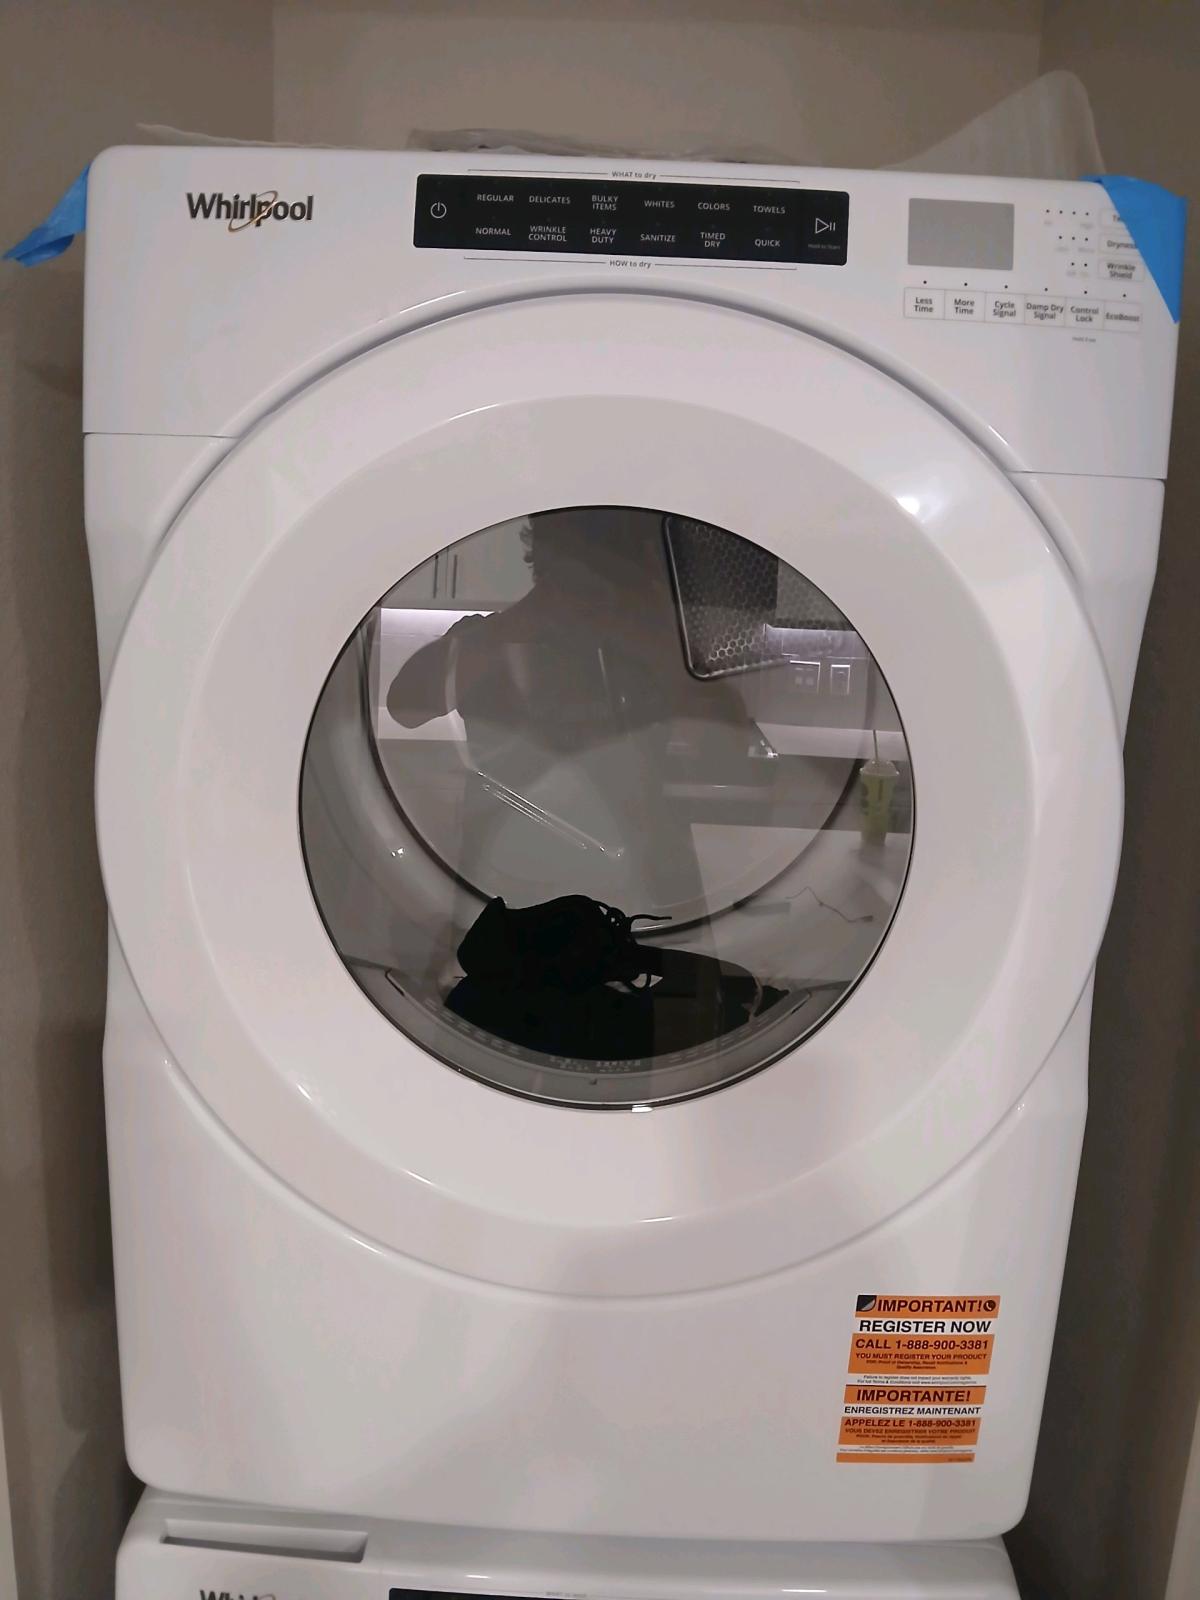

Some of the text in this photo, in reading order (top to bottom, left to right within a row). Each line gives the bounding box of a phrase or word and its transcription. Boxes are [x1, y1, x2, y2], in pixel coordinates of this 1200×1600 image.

[611, 170, 633, 178] WHAT
[644, 172, 656, 180] dry
[476, 193, 514, 203] REGULAR
[528, 195, 571, 205] DELICATES
[591, 195, 619, 203] BULKY
[186, 192, 314, 227] Whirlpool
[592, 203, 617, 211] ITEMS
[643, 200, 676, 209] WHITES
[697, 202, 730, 212] COLORS
[752, 205, 786, 215] TOWELS
[475, 227, 512, 237] NORMAL
[529, 225, 567, 234] WRINKLE
[589, 228, 617, 236] HEAVY
[528, 233, 567, 242] CONTROL
[591, 236, 615, 244] DUTY
[639, 233, 677, 243] SANITIZE
[700, 231, 726, 240] TIMED
[704, 239, 721, 248] DRY
[754, 238, 781, 248] QUICK
[639, 261, 652, 269] dry
[1106, 262, 1136, 272] Wrinkle
[1109, 270, 1133, 280] Shield
[915, 296, 933, 305] Less
[954, 298, 975, 307] More
[994, 300, 1015, 311] Cycle
[914, 304, 934, 313] Time
[954, 306, 974, 316] Time
[992, 308, 1017, 319] Signal
[1026, 302, 1064, 315] Damp Dry
[1070, 306, 1099, 315] Control
[1033, 311, 1056, 322] Signal
[1075, 314, 1093, 323] Lock
[1105, 311, 1140, 323] EcoBoost
[877, 1299, 982, 1313] IMPORTANT!
[859, 1320, 992, 1333] REGISTER NOW
[855, 1338, 989, 1350] CALL 1-888-900-3381
[857, 1390, 971, 1402] IMPORTANTE!
[844, 1406, 981, 1415] ENREGISTREZ MAINTENANT
[844, 1419, 890, 1427] APPELEZ
[908, 1420, 976, 1428] 1-888-900-3381
